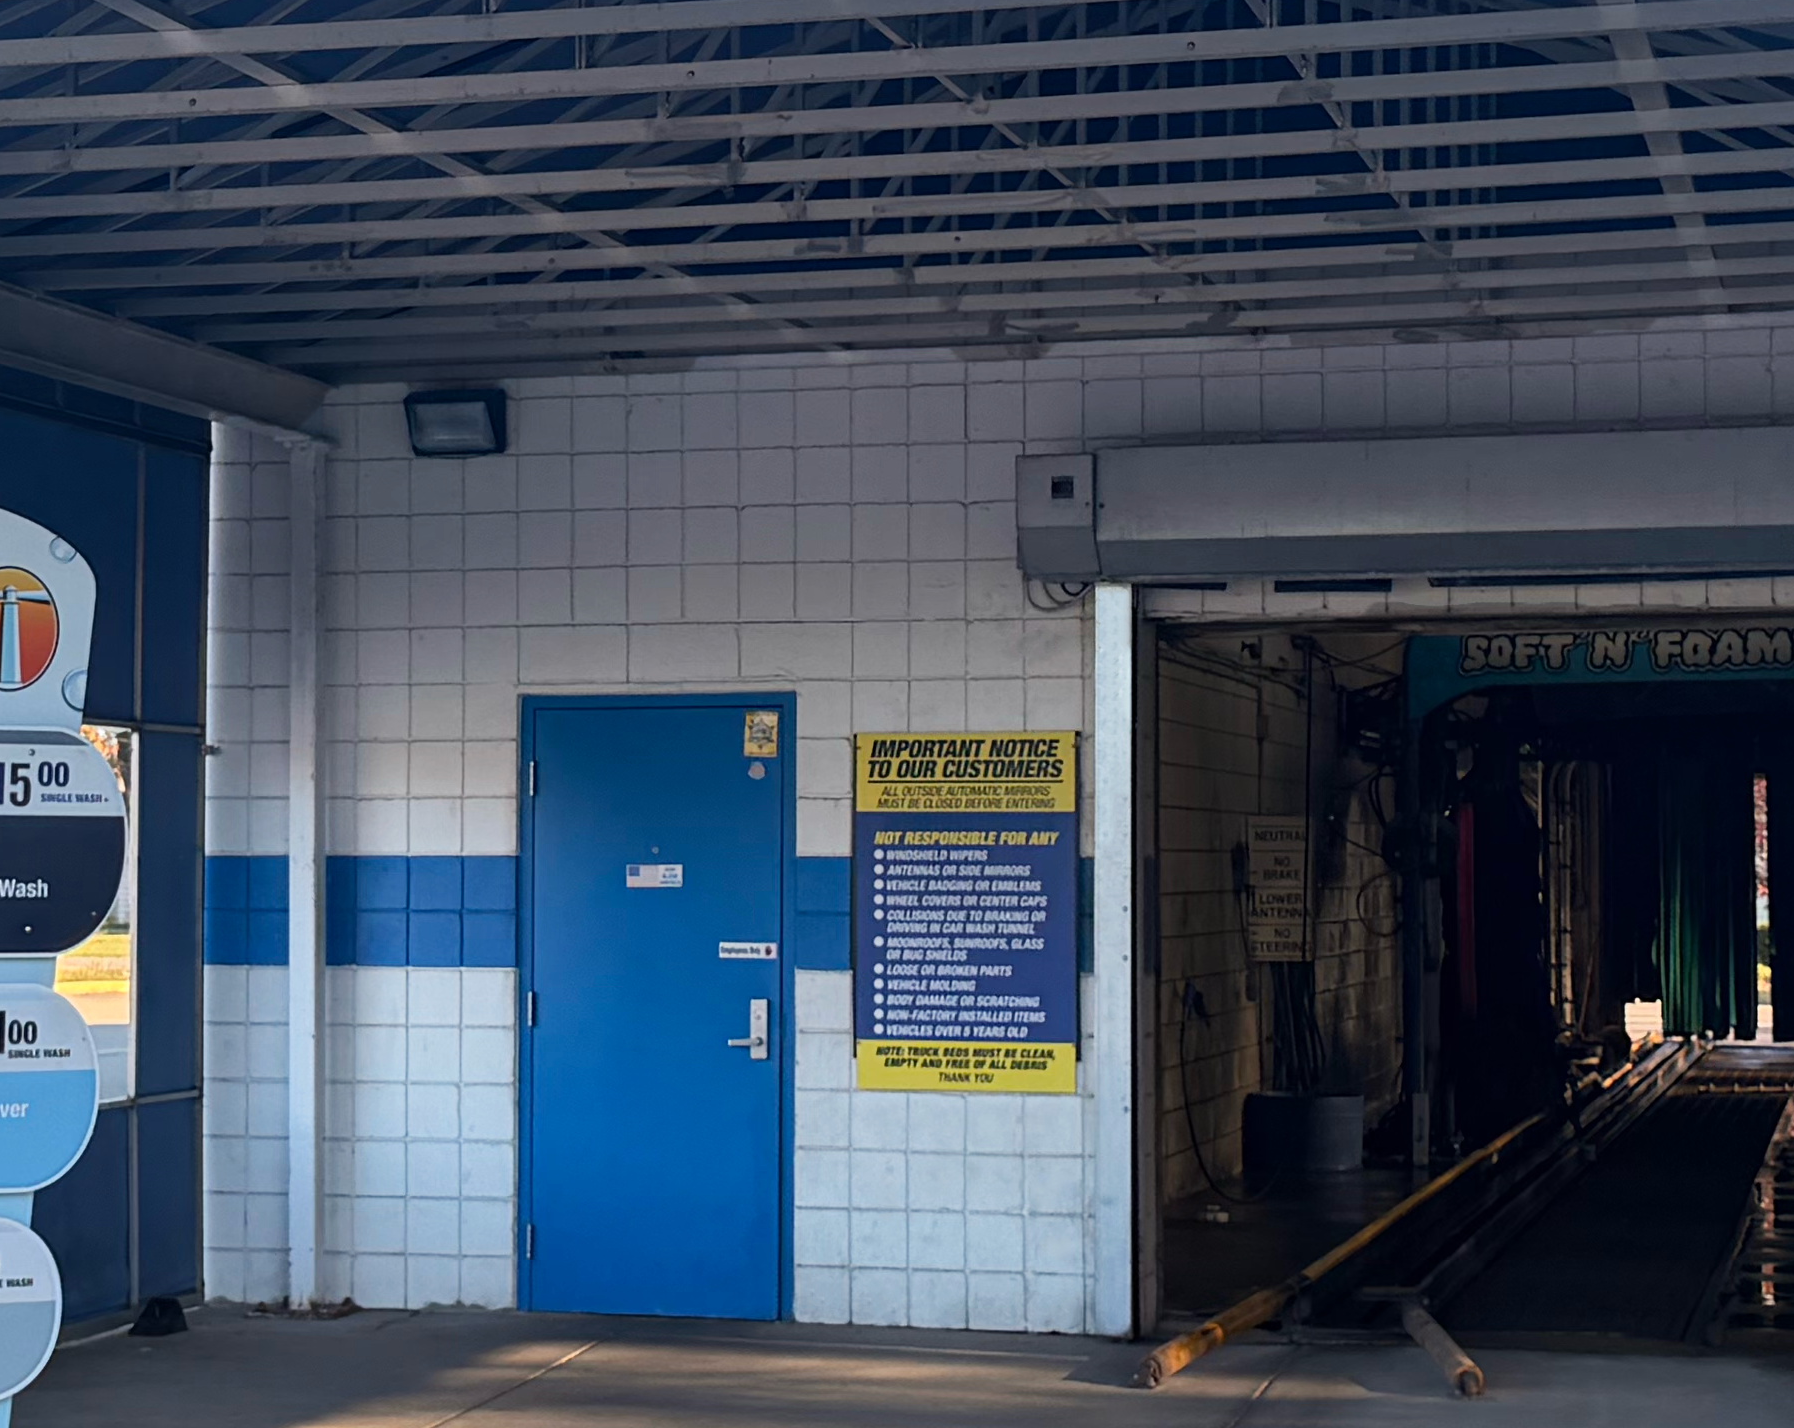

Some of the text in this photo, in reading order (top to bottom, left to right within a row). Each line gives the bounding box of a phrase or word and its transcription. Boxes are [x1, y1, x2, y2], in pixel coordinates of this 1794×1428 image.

[1460, 633, 1577, 674] SOFT
[870, 739, 1060, 758] IMPORTANT NOTICE
[868, 759, 1064, 778] TO OUR CUSTOMERS
[882, 786, 1051, 797] ALL OUTSIDE AUTOMATIC MIRRORS
[876, 797, 1055, 809] MUST BE CLOSED BEFORE ENTERING
[874, 831, 1059, 845] NOT RESPONSIBLE FOR ANY
[886, 850, 988, 860] WINDSHIELD WIPERS
[886, 865, 1031, 876] ANTENNAS OR SIDE MIRRORS
[886, 880, 1042, 891] VEHICLE BADGING OR EMBLEMS
[886, 895, 1048, 907] WHEEL COVERS OR CENTER CAPS
[886, 911, 1046, 922] COLLISIONS DUE TO BRAKING OR
[886, 923, 1035, 934] DRIVING IN CAR WASH TUNNEL
[886, 950, 968, 961] OR BUG SHIELDS
[886, 965, 1013, 976] LOOSE OR BROKEN PARTS
[886, 980, 976, 991] VEHICLE MOLDING
[886, 995, 1041, 1007] BODY DAMAGE OR SCRATCHING
[886, 1010, 1046, 1022] NON-FACTORY INSTALLED ITEMS
[886, 1025, 933, 1036] VEHICLES
[934, 1026, 962, 1037] OVER
[972, 1026, 1006, 1037] YEARS
[1007, 1027, 1028, 1037] OLD
[876, 1046, 1056, 1060] NOTE: TRUCK BEDS MUST BE CLEAN,
[884, 1057, 1048, 1071] EMPTY AND FREE OF ALL DEBRIS
[938, 1072, 994, 1083] THANK YOU
